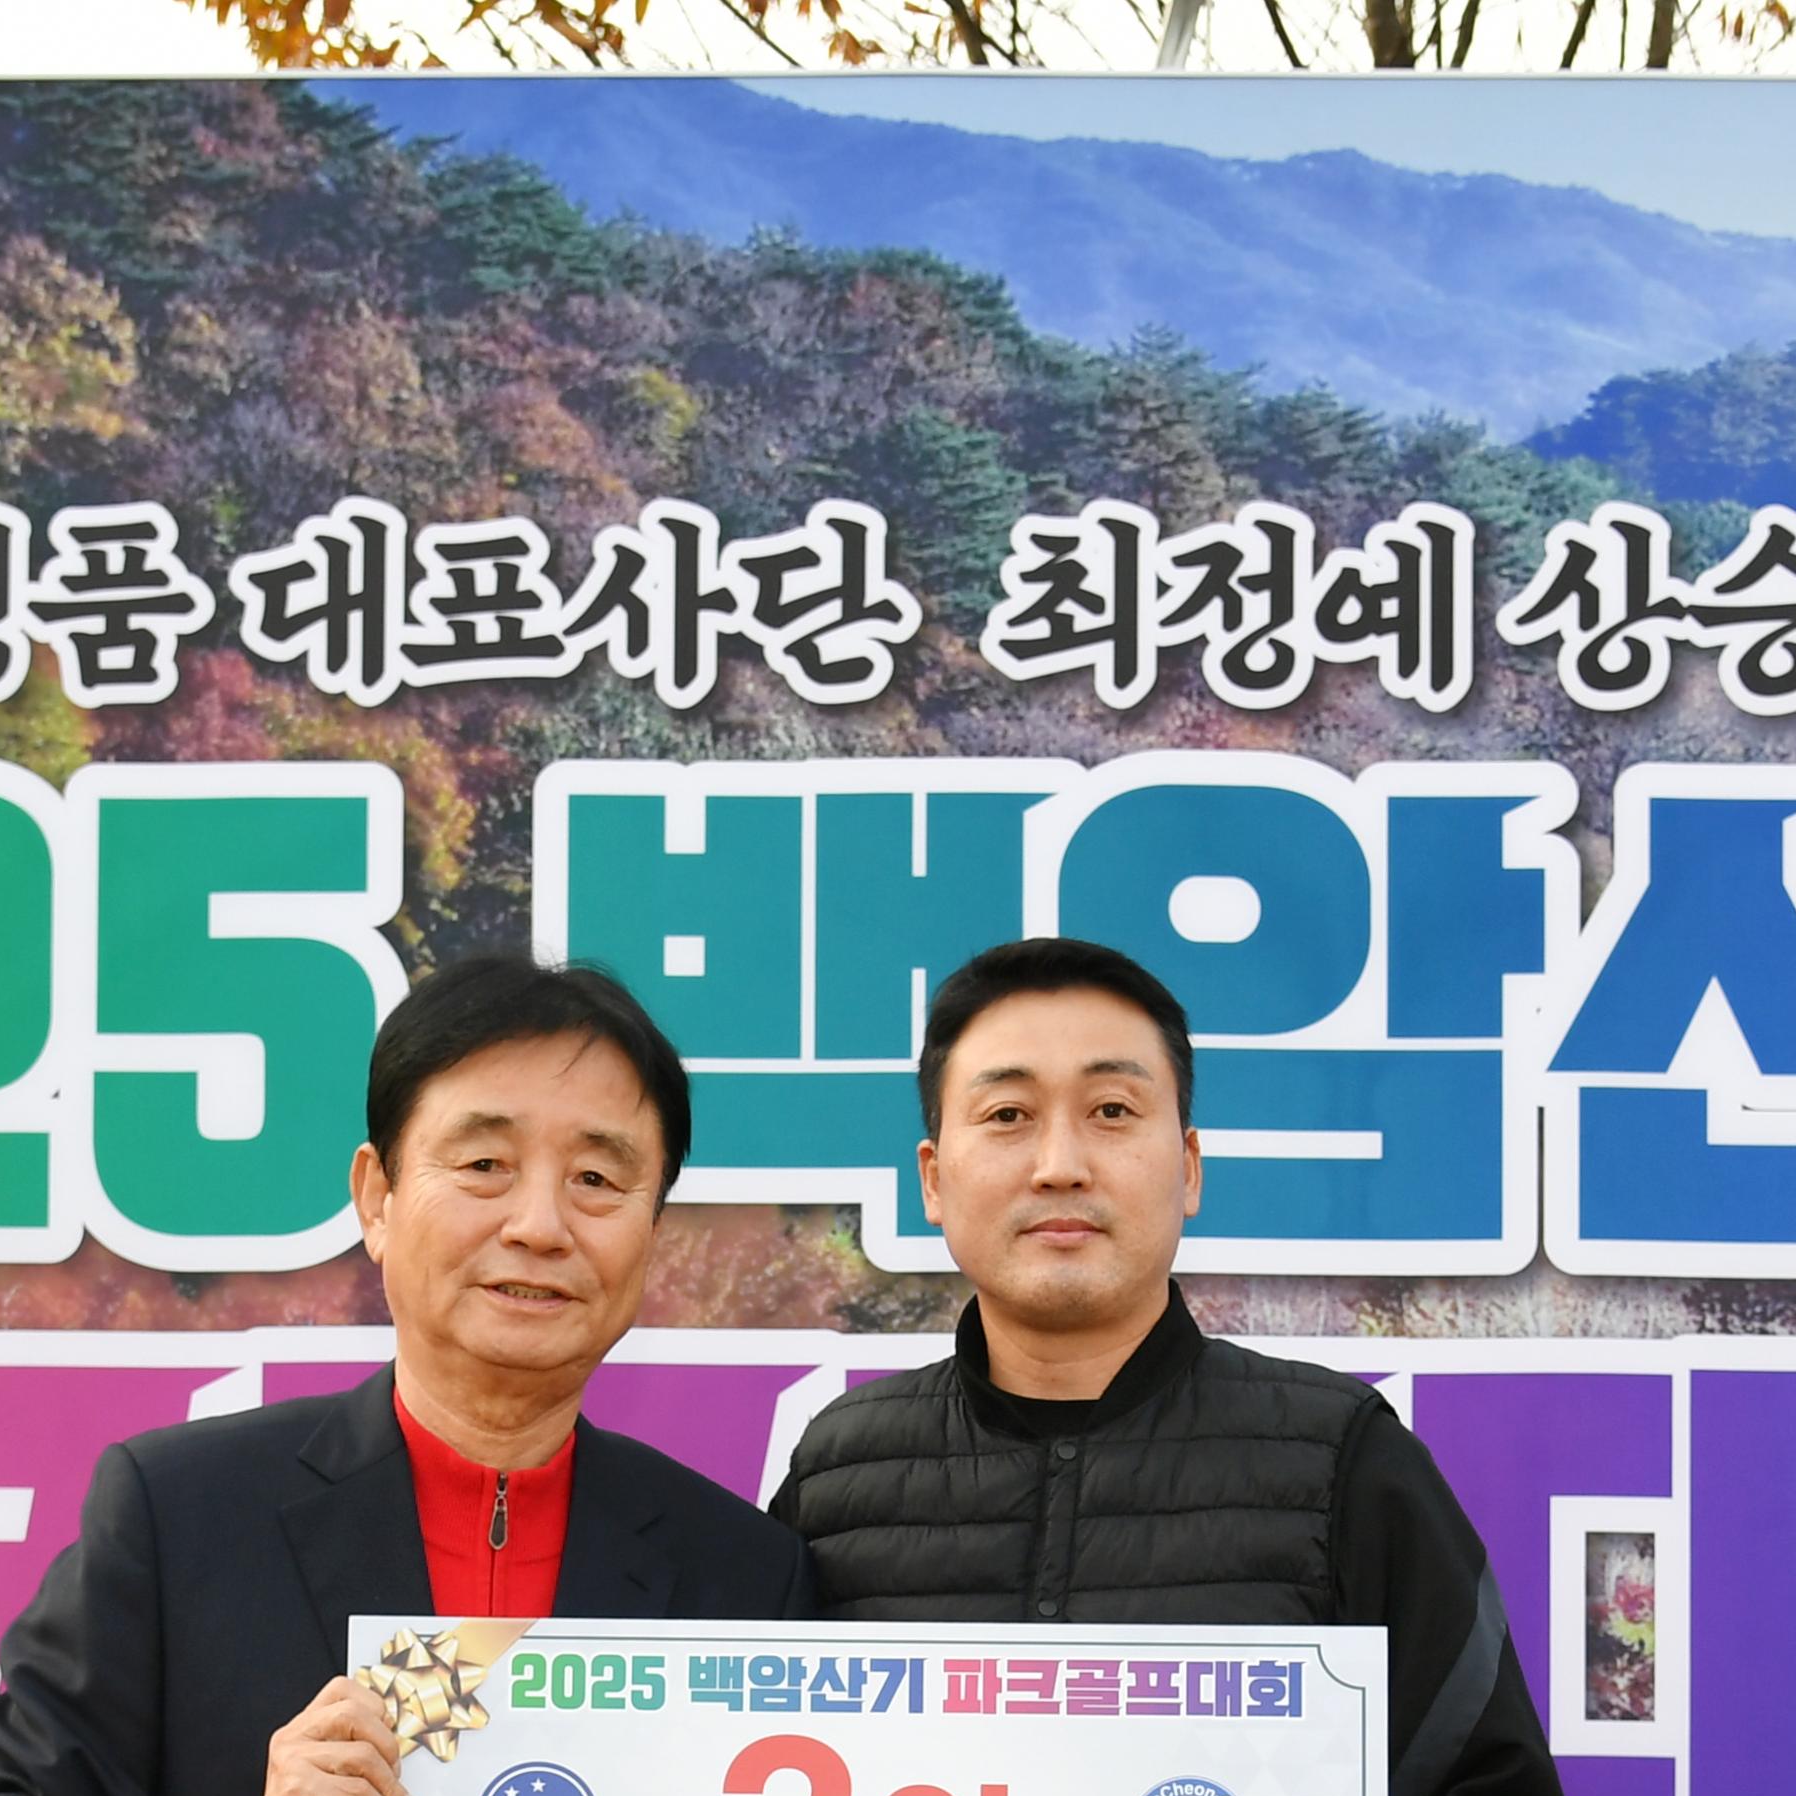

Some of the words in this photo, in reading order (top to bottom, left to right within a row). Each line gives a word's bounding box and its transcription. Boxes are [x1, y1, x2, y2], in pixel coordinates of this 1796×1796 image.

[248, 514, 908, 693] 대표사단
[1003, 516, 1457, 693] 최정예
[510, 1652, 666, 1712] 2025
[688, 1654, 926, 1714] 백암산기
[941, 1657, 1304, 1720] 파크골프대회
